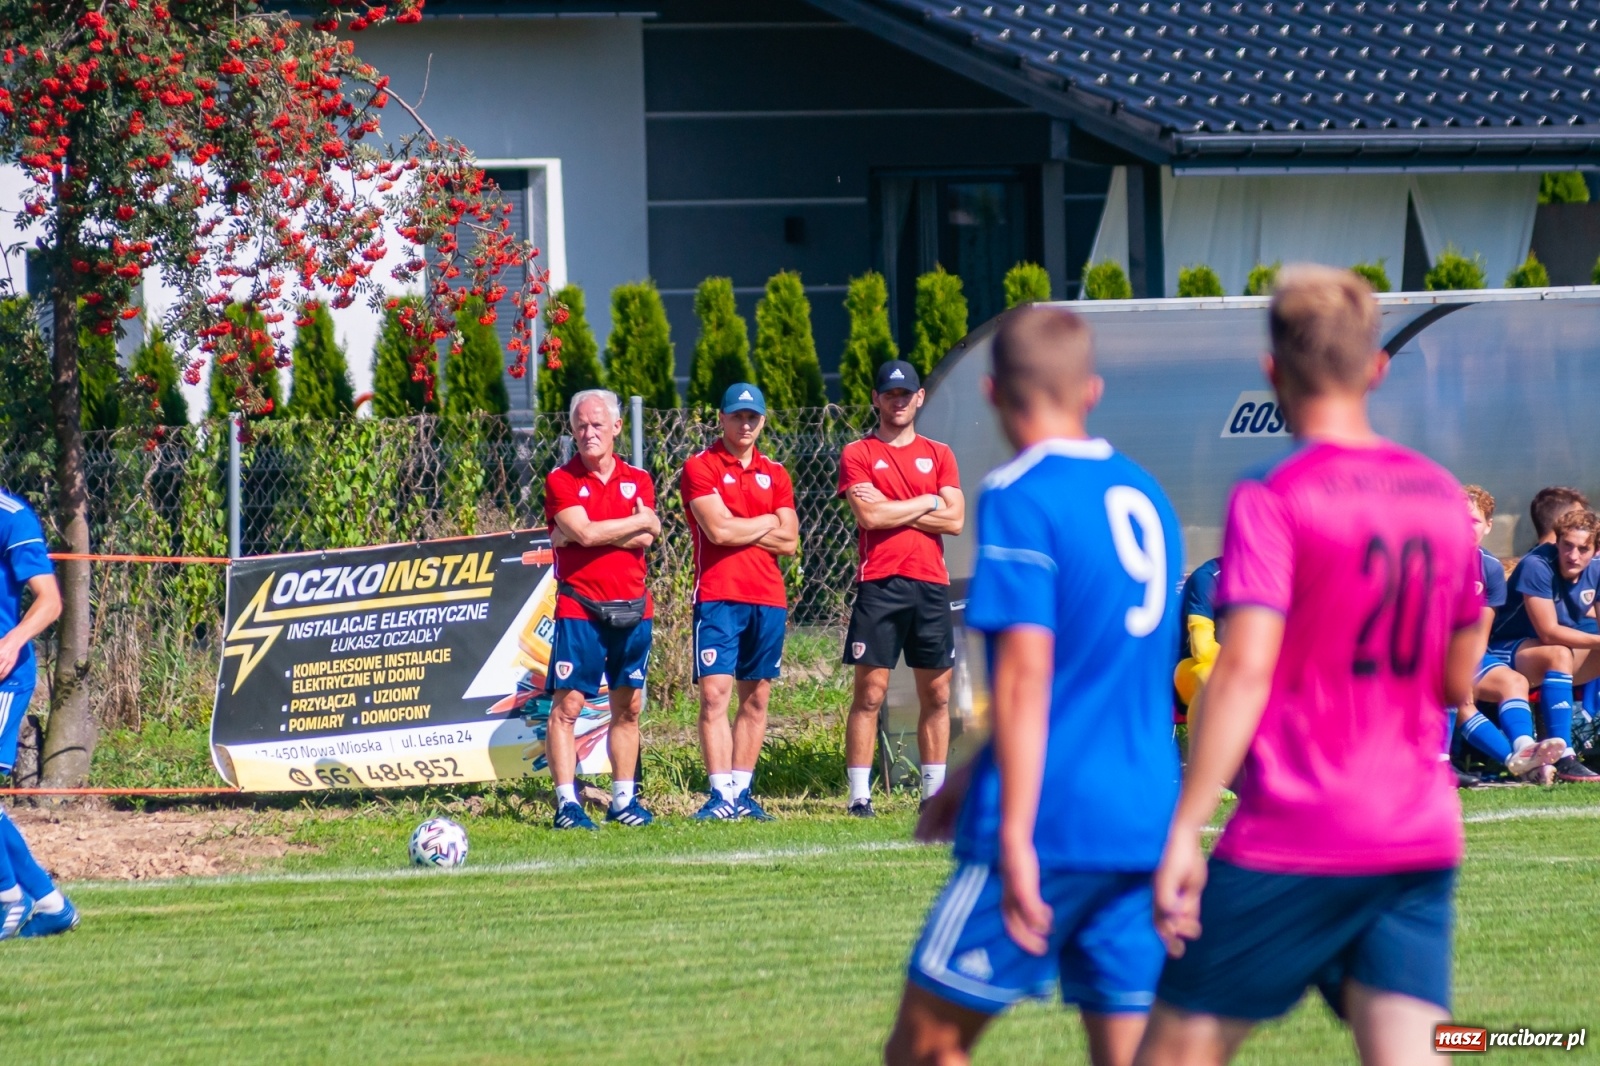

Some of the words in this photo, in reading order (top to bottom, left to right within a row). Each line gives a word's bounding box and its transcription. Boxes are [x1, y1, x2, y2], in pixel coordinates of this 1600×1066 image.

[1229, 401, 1293, 434] GOS
[1103, 485, 1168, 638] 9
[272, 551, 495, 605] OCZKOINSTAL
[287, 611, 378, 640] INSTALACJE
[379, 602, 489, 629] ELEKTRYCZNE
[1352, 536, 1432, 678] 20
[330, 632, 380, 653] ŁUKASZ
[382, 626, 443, 646] OCZADŁY
[292, 655, 382, 679] KOMPLEKSOWE
[384, 647, 452, 668] INSTALACJE
[292, 672, 370, 694] ELEKTRYCZNE
[373, 670, 387, 685] W
[388, 666, 426, 683] DOMU
[290, 692, 357, 713] PRZYŁĄCZA
[373, 685, 421, 704] UZIOMY
[288, 713, 346, 733] POMIARY
[360, 704, 432, 726] DOMOFONY
[300, 745, 336, 759] Nowa
[336, 739, 383, 755] Wioska
[401, 737, 417, 749] ul.
[419, 732, 455, 747] Leśna
[457, 730, 473, 743] 24
[315, 766, 364, 788] 661
[366, 762, 415, 782] 484
[413, 756, 464, 779] 852
